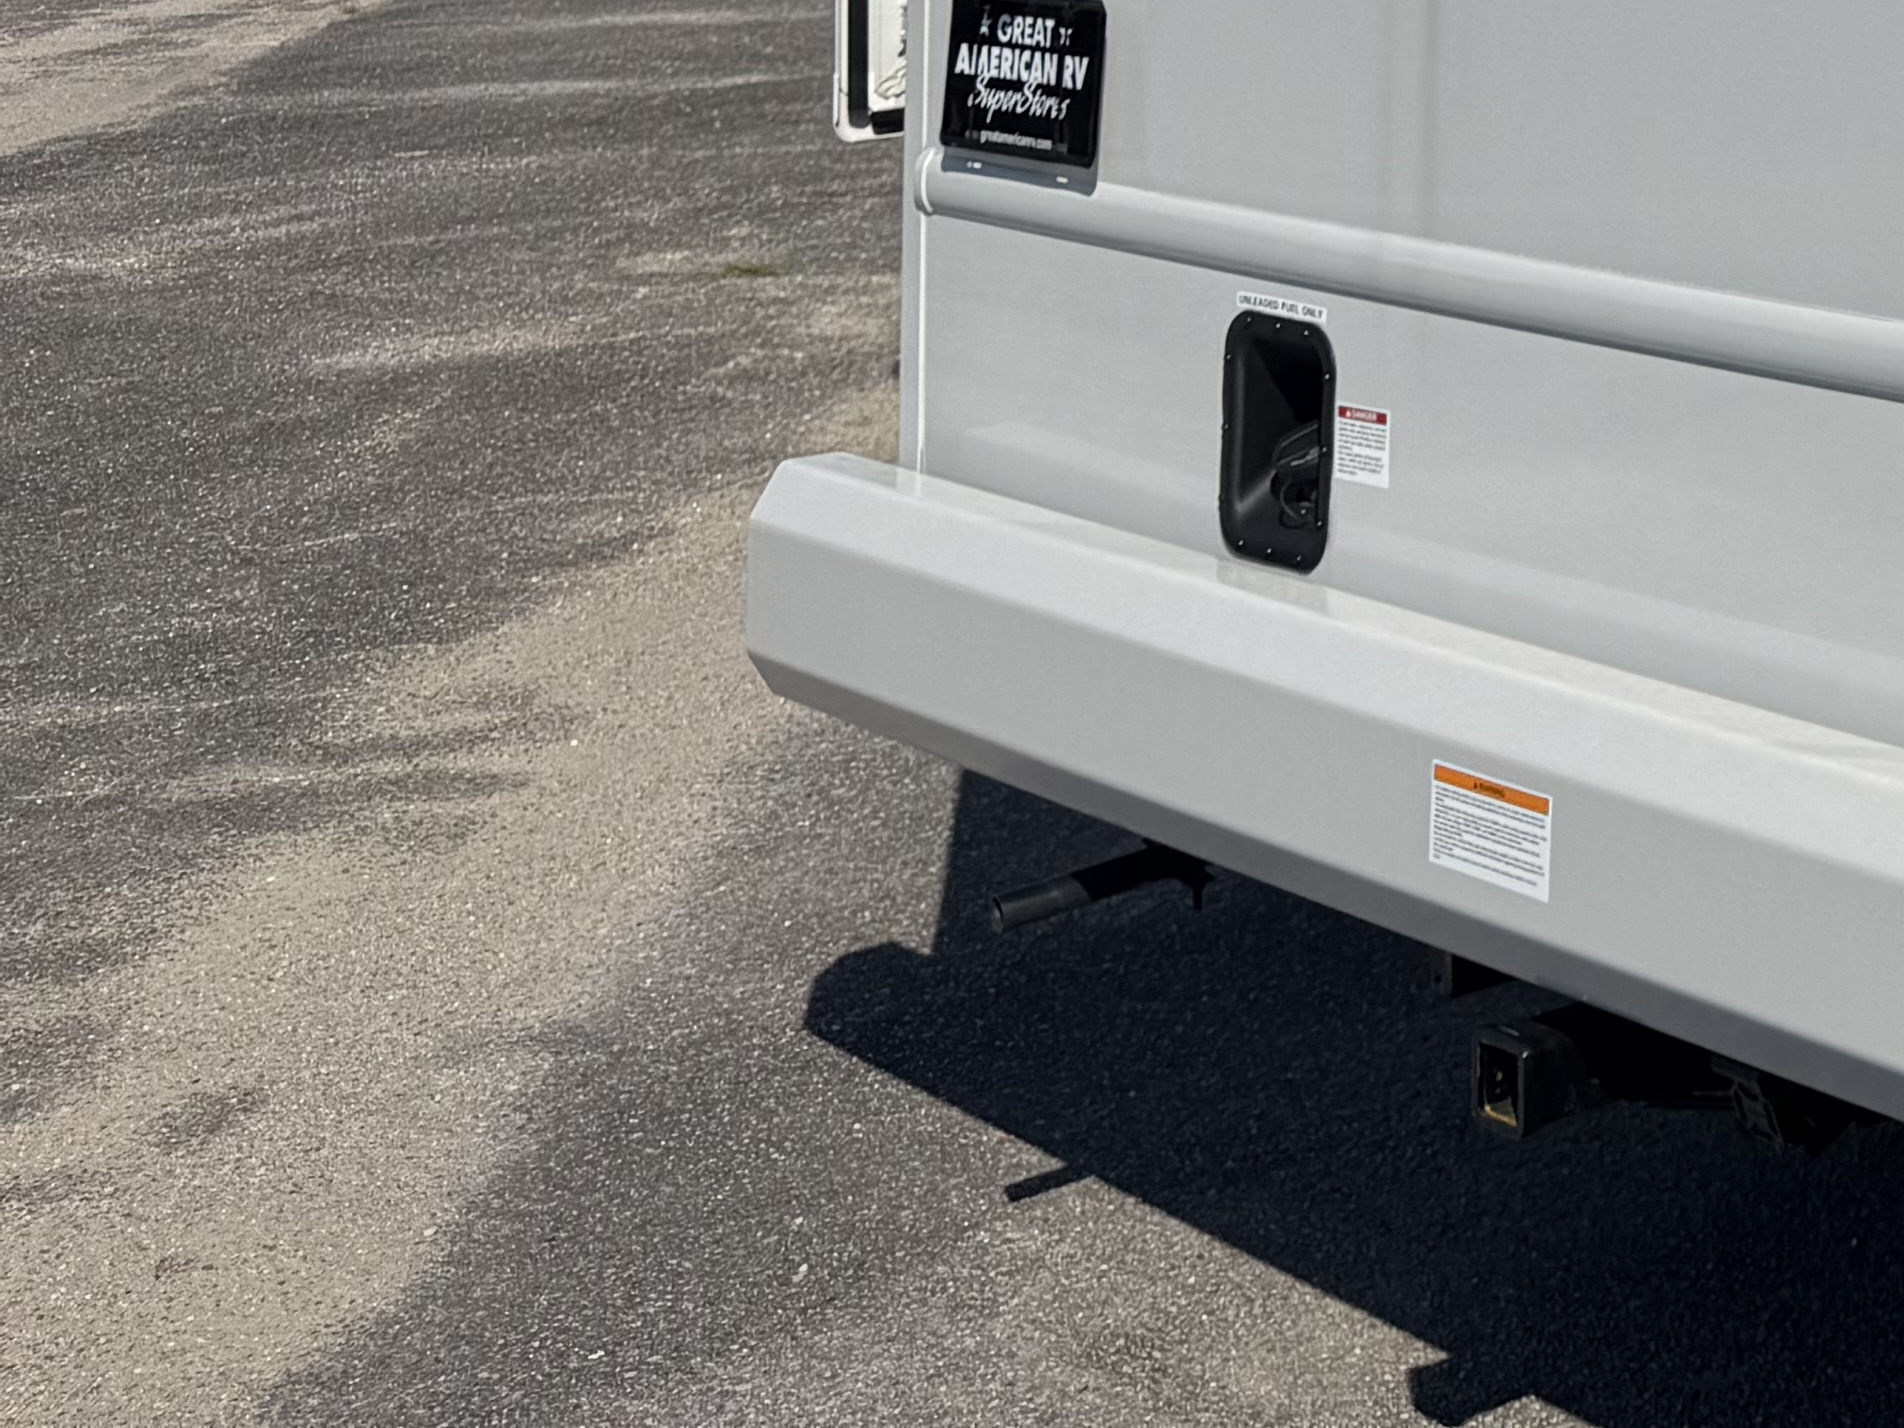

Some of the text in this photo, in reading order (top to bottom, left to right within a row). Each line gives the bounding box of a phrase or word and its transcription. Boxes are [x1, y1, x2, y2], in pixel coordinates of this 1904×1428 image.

[997, 13, 1055, 48] GREAT
[954, 42, 1090, 91] AMERICAN RV
